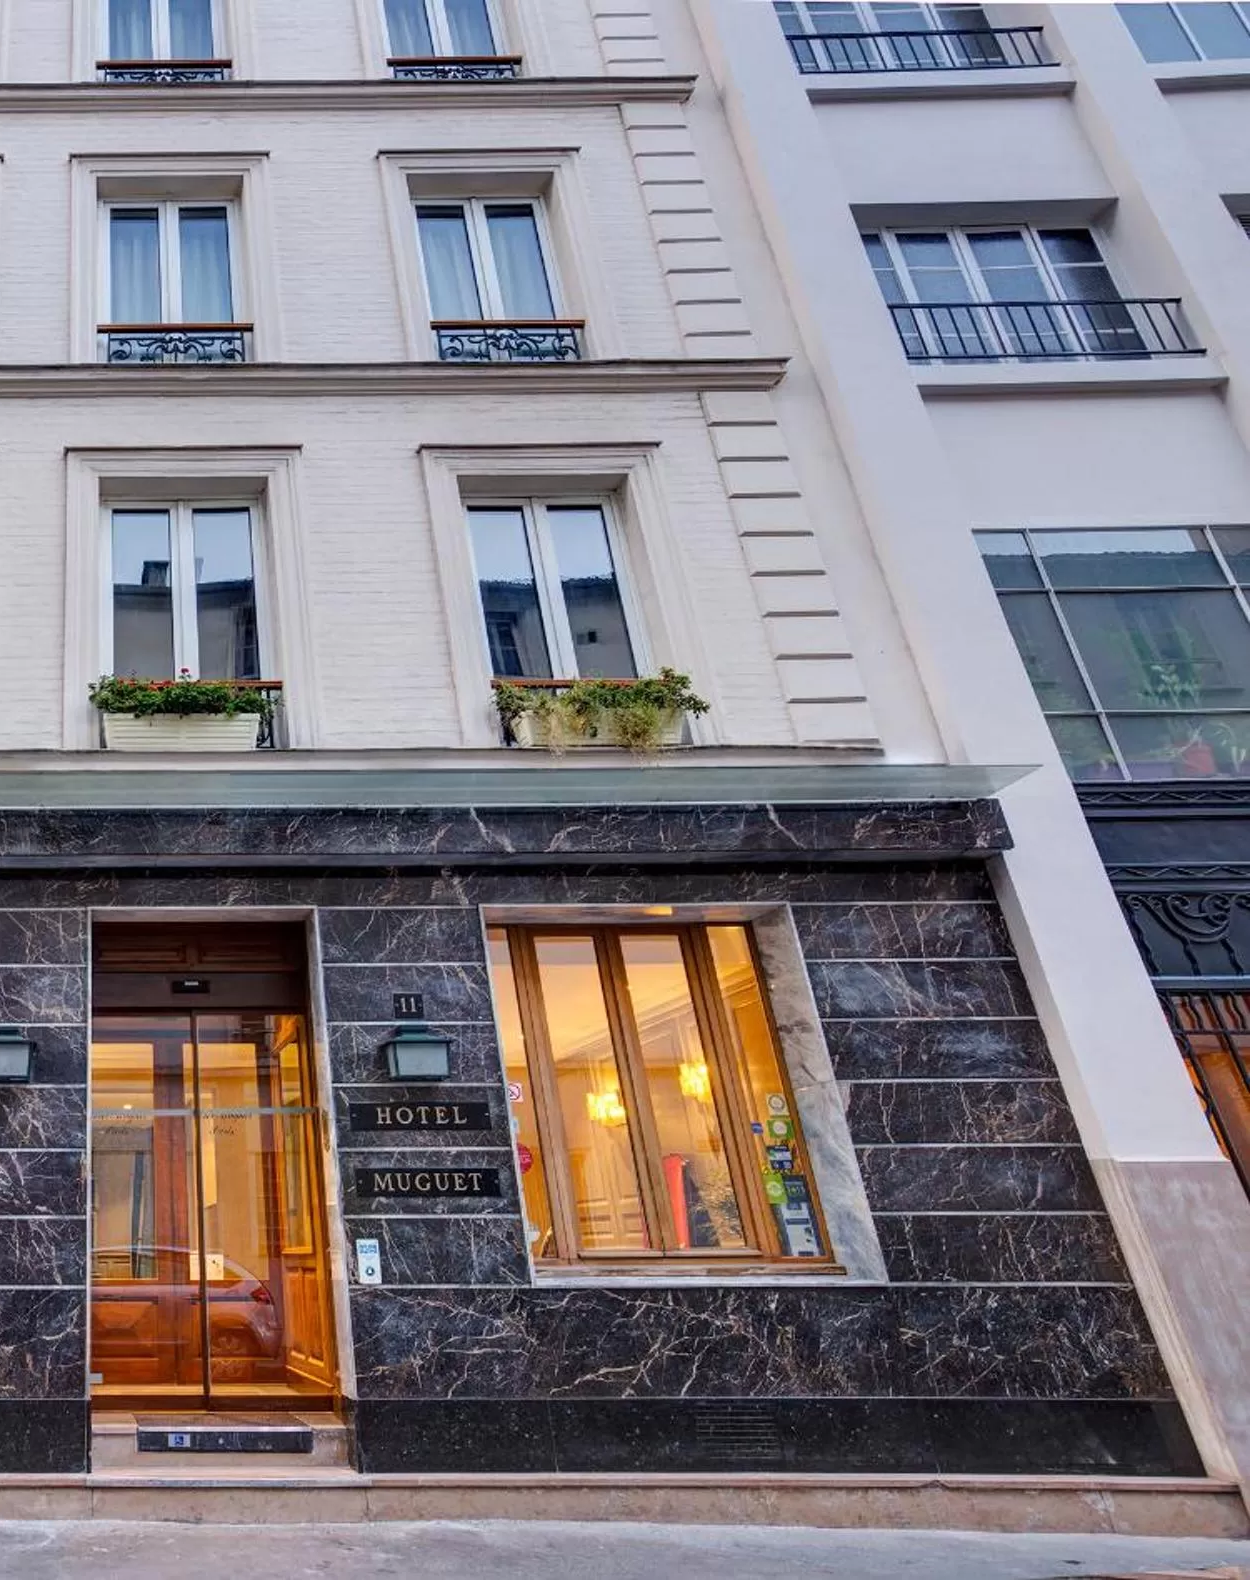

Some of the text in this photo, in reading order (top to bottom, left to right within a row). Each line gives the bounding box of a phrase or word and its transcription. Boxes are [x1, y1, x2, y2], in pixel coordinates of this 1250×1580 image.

[400, 997, 417, 1012] 11
[376, 1106, 468, 1124] HOTEL
[373, 1172, 482, 1191] MUGUET
